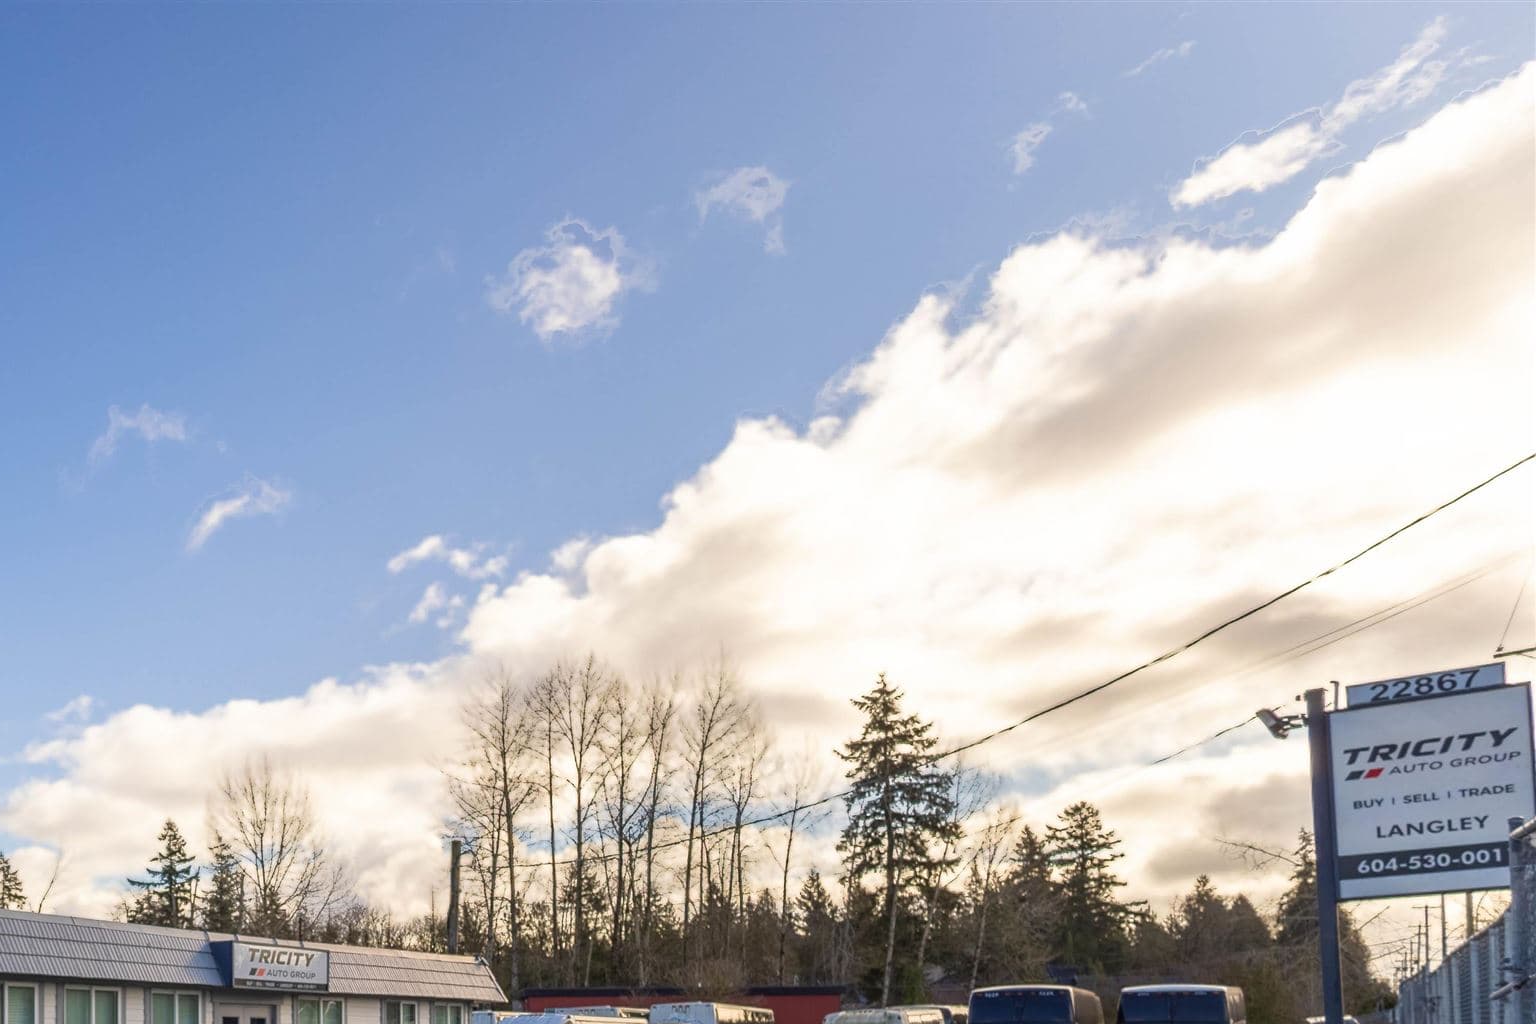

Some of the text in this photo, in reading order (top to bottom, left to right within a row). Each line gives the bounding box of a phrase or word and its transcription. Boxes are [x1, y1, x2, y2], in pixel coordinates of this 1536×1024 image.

[1370, 669, 1480, 701] 22867
[1343, 727, 1518, 765] TRICITY
[1389, 751, 1521, 776] AUTO GROUP
[1353, 798, 1385, 810] BUY
[1403, 791, 1440, 805] SELL
[1459, 783, 1516, 799] TRADE
[1376, 815, 1489, 839] LANGLEY
[1357, 848, 1504, 874] 604-530-001
[248, 948, 315, 967] TRICITY
[267, 969, 316, 980] AUTO GROUP
